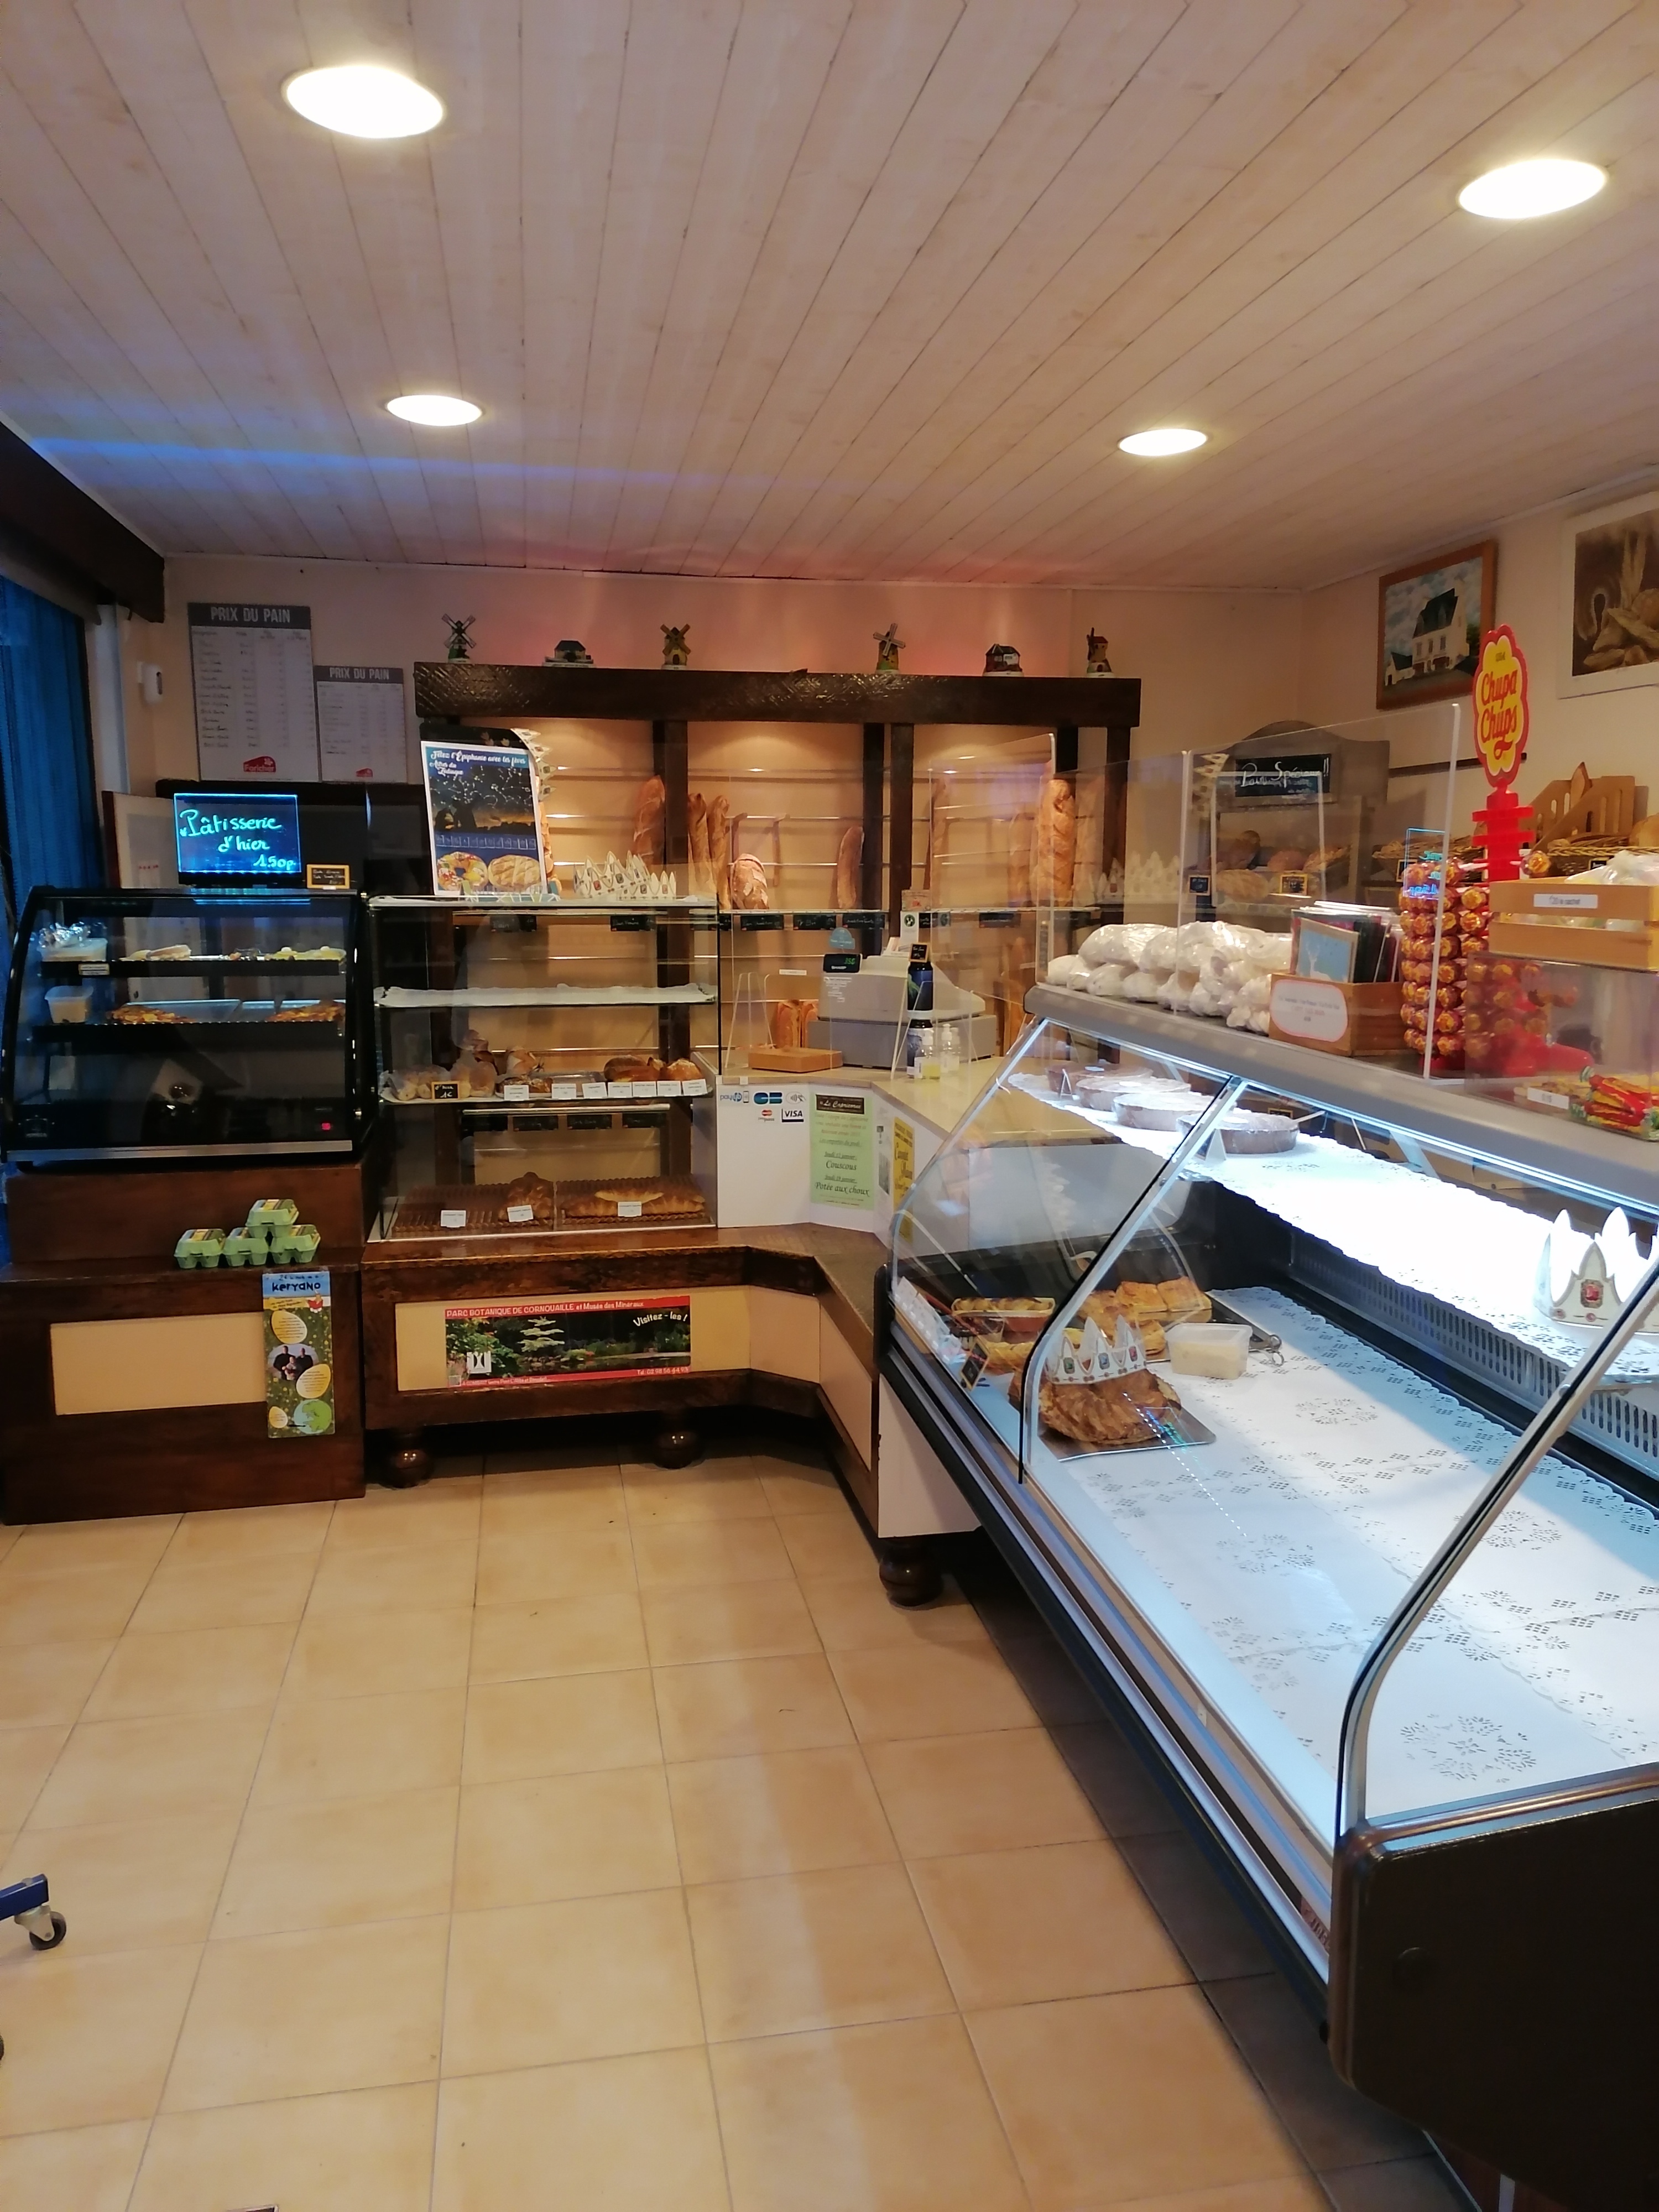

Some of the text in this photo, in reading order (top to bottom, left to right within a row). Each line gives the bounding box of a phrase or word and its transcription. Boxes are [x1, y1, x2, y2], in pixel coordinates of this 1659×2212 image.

[211, 607, 290, 623] PRIX DU PAIN
[330, 667, 389, 680] PRIX DU PAIN
[1481, 670, 1517, 709] Chupa
[1481, 705, 1517, 759] Chups
[179, 809, 282, 837] Pâtisserie
[826, 1160, 857, 1171] Couscous
[834, 1186, 848, 1194] aux
[849, 1185, 870, 1197] choux
[469, 1307, 512, 1316] BOTANIQUE
[524, 1303, 575, 1313] CORNOUAILLE
